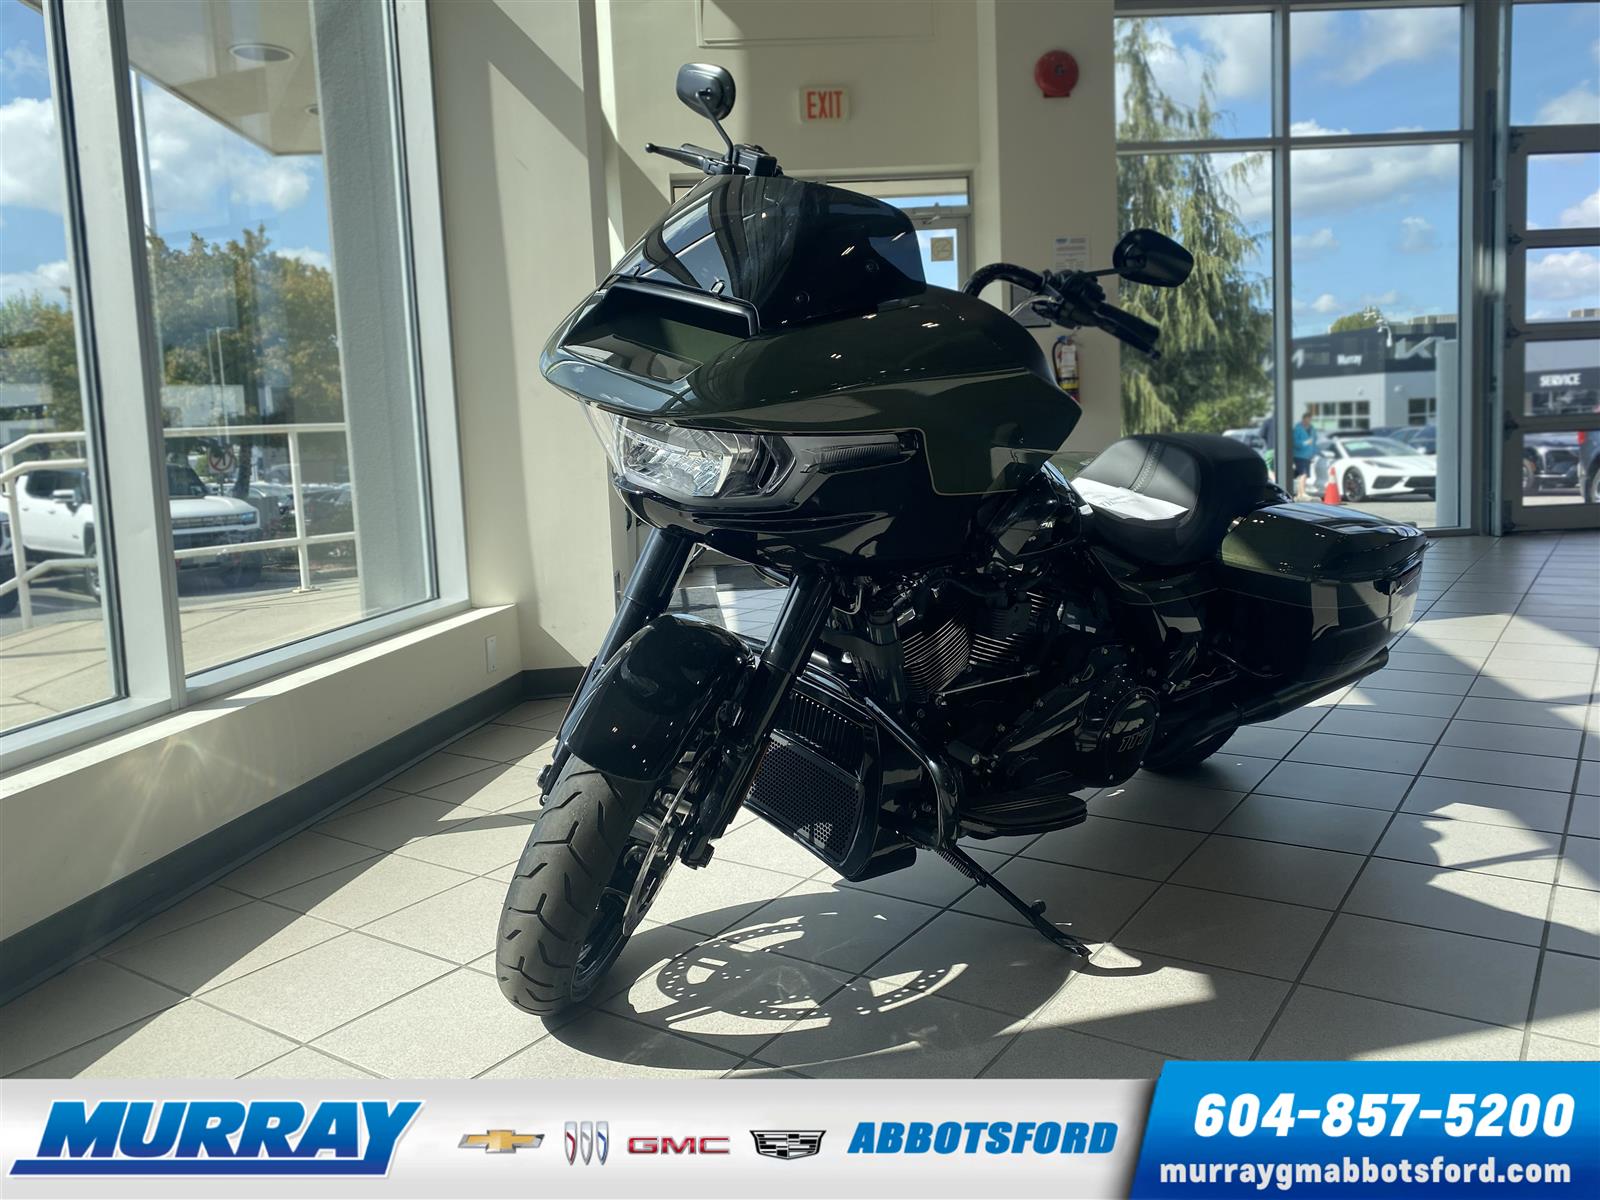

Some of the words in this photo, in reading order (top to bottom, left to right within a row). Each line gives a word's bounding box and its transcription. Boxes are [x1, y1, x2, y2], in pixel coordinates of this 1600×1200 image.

[805, 90, 843, 119] EXIT
[1336, 354, 1362, 366] Murray
[1540, 373, 1581, 387] SERVICE
